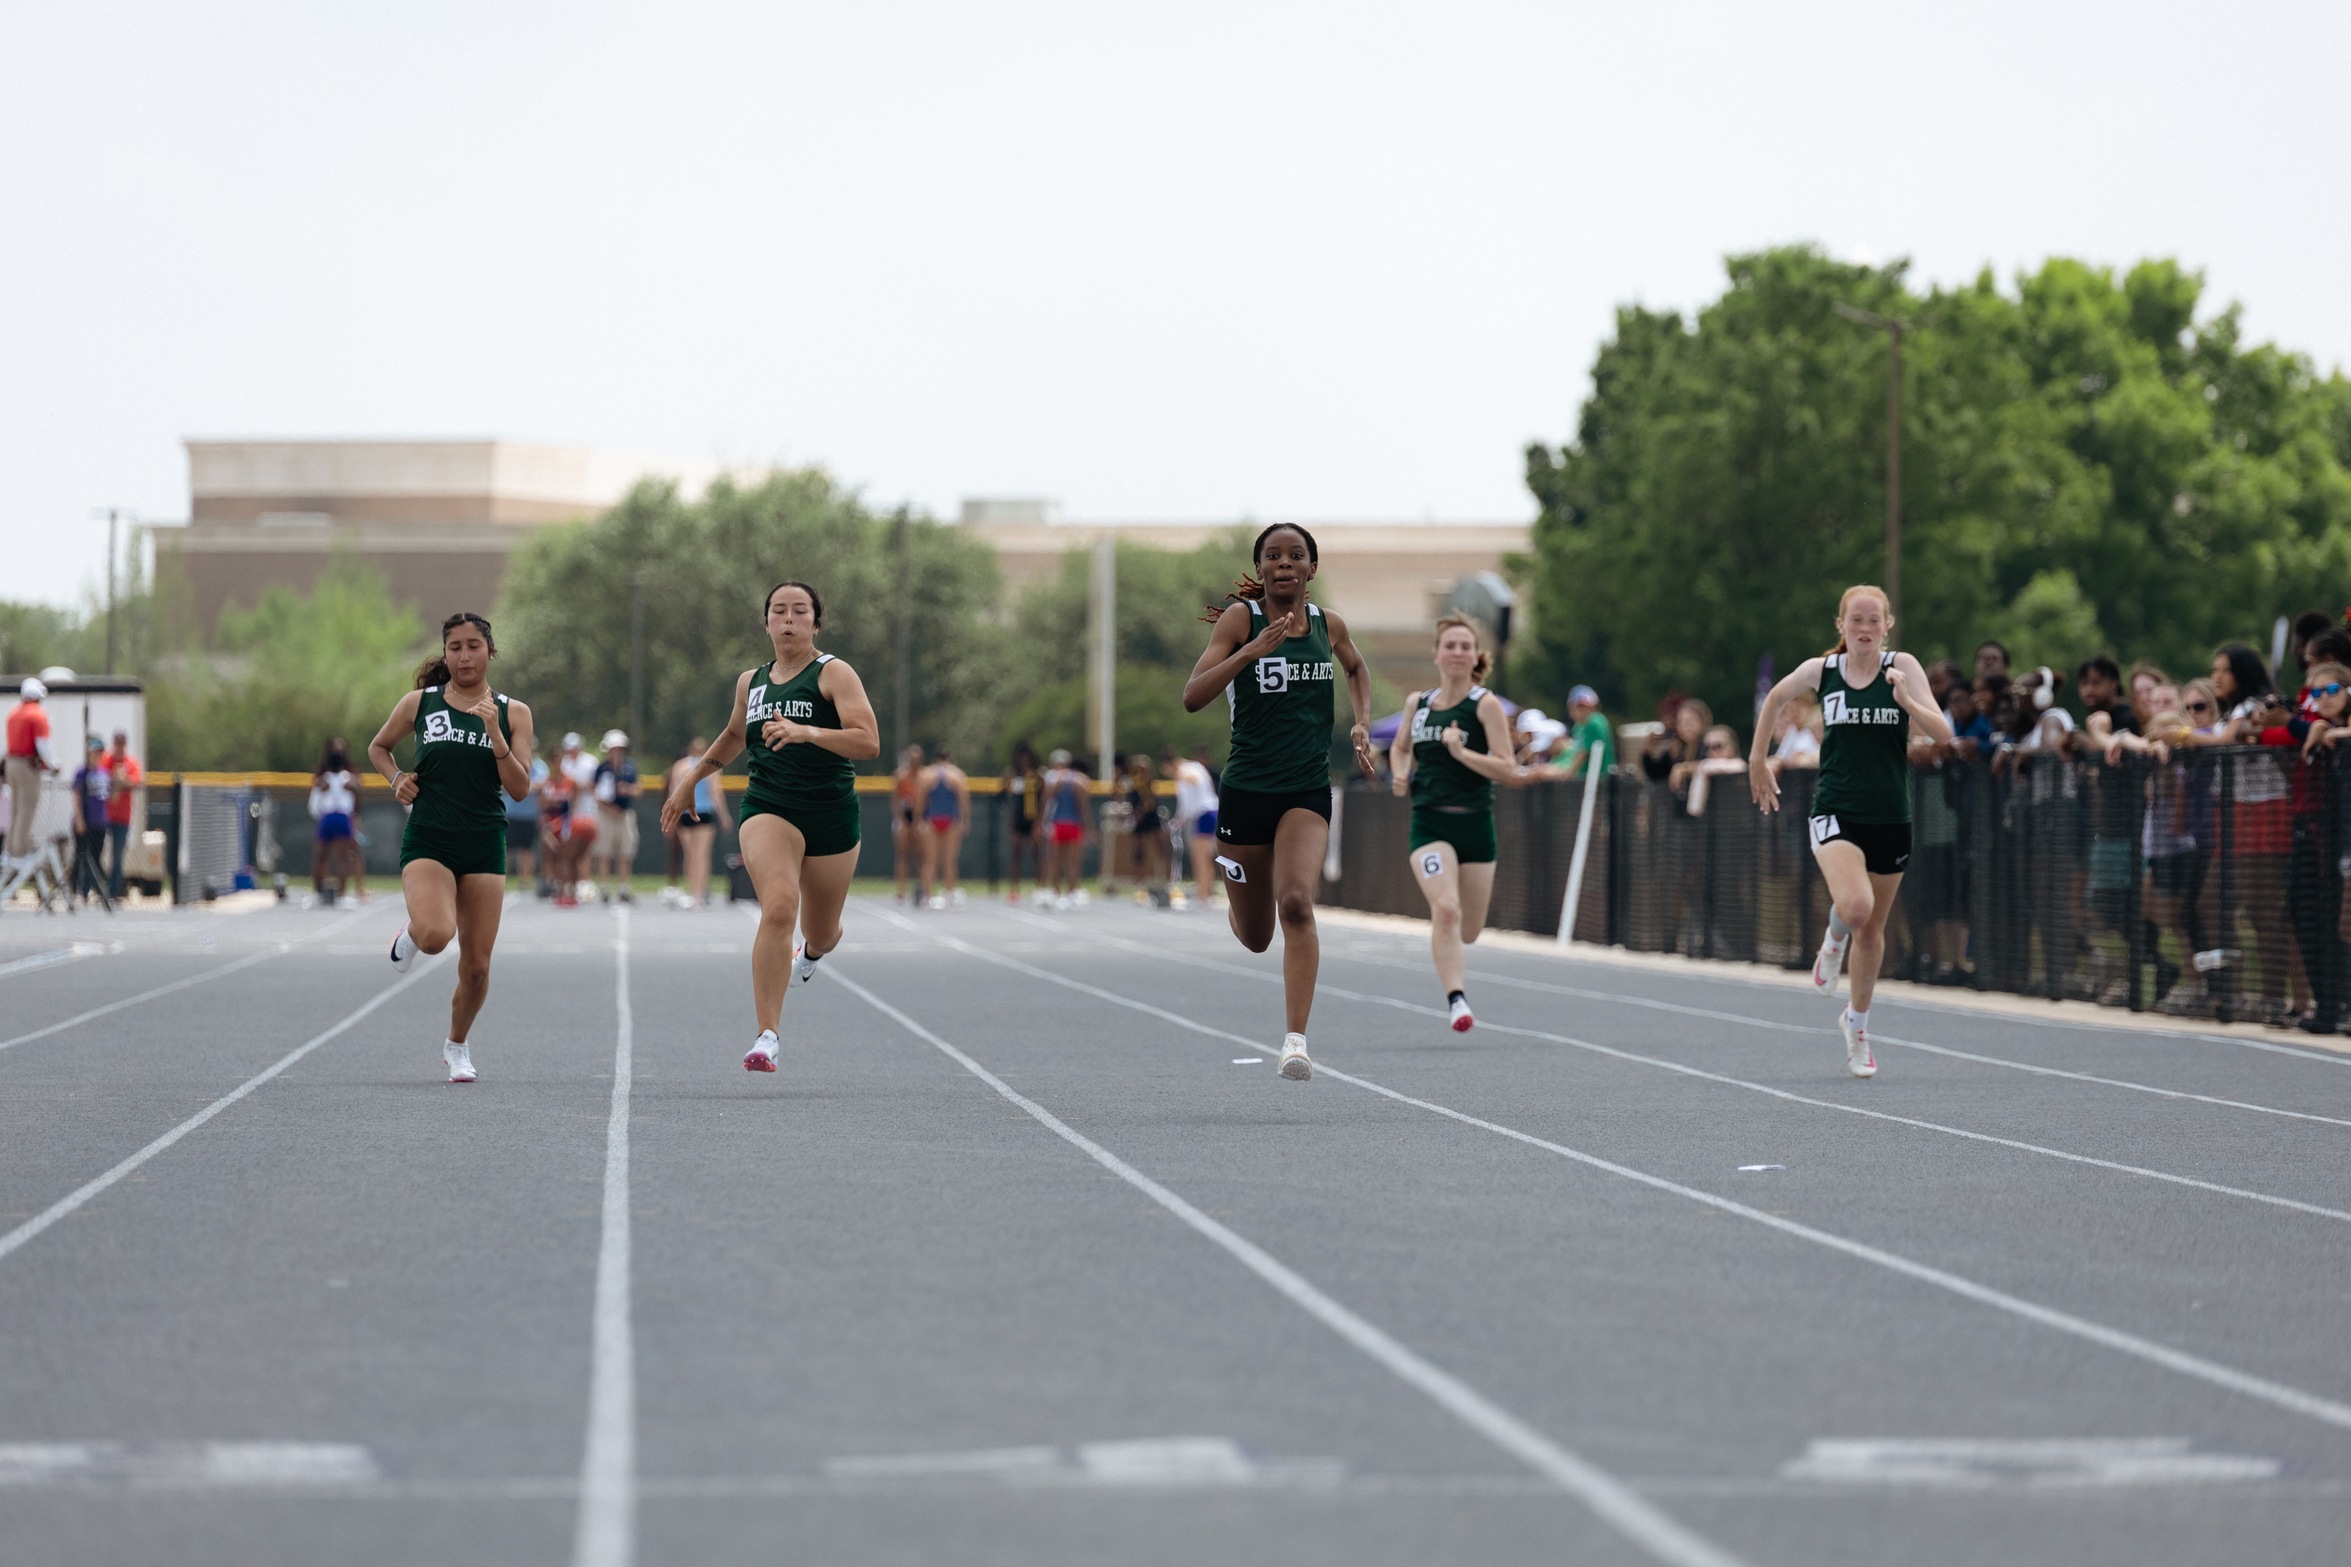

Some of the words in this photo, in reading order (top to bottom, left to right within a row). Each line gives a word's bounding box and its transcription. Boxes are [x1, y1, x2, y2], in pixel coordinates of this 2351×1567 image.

[1263, 661, 1284, 691] 5
[1301, 662, 1311, 680] &
[1311, 662, 1334, 680] ARTS
[748, 689, 762, 713] 4
[783, 700, 813, 718] ARTS
[1827, 695, 1841, 721] 7
[430, 714, 449, 738] 3
[1861, 707, 1871, 724] &
[1872, 707, 1900, 725] ARTS
[467, 731, 477, 745] &
[1816, 814, 1832, 837] 7
[1424, 855, 1440, 874] 6
